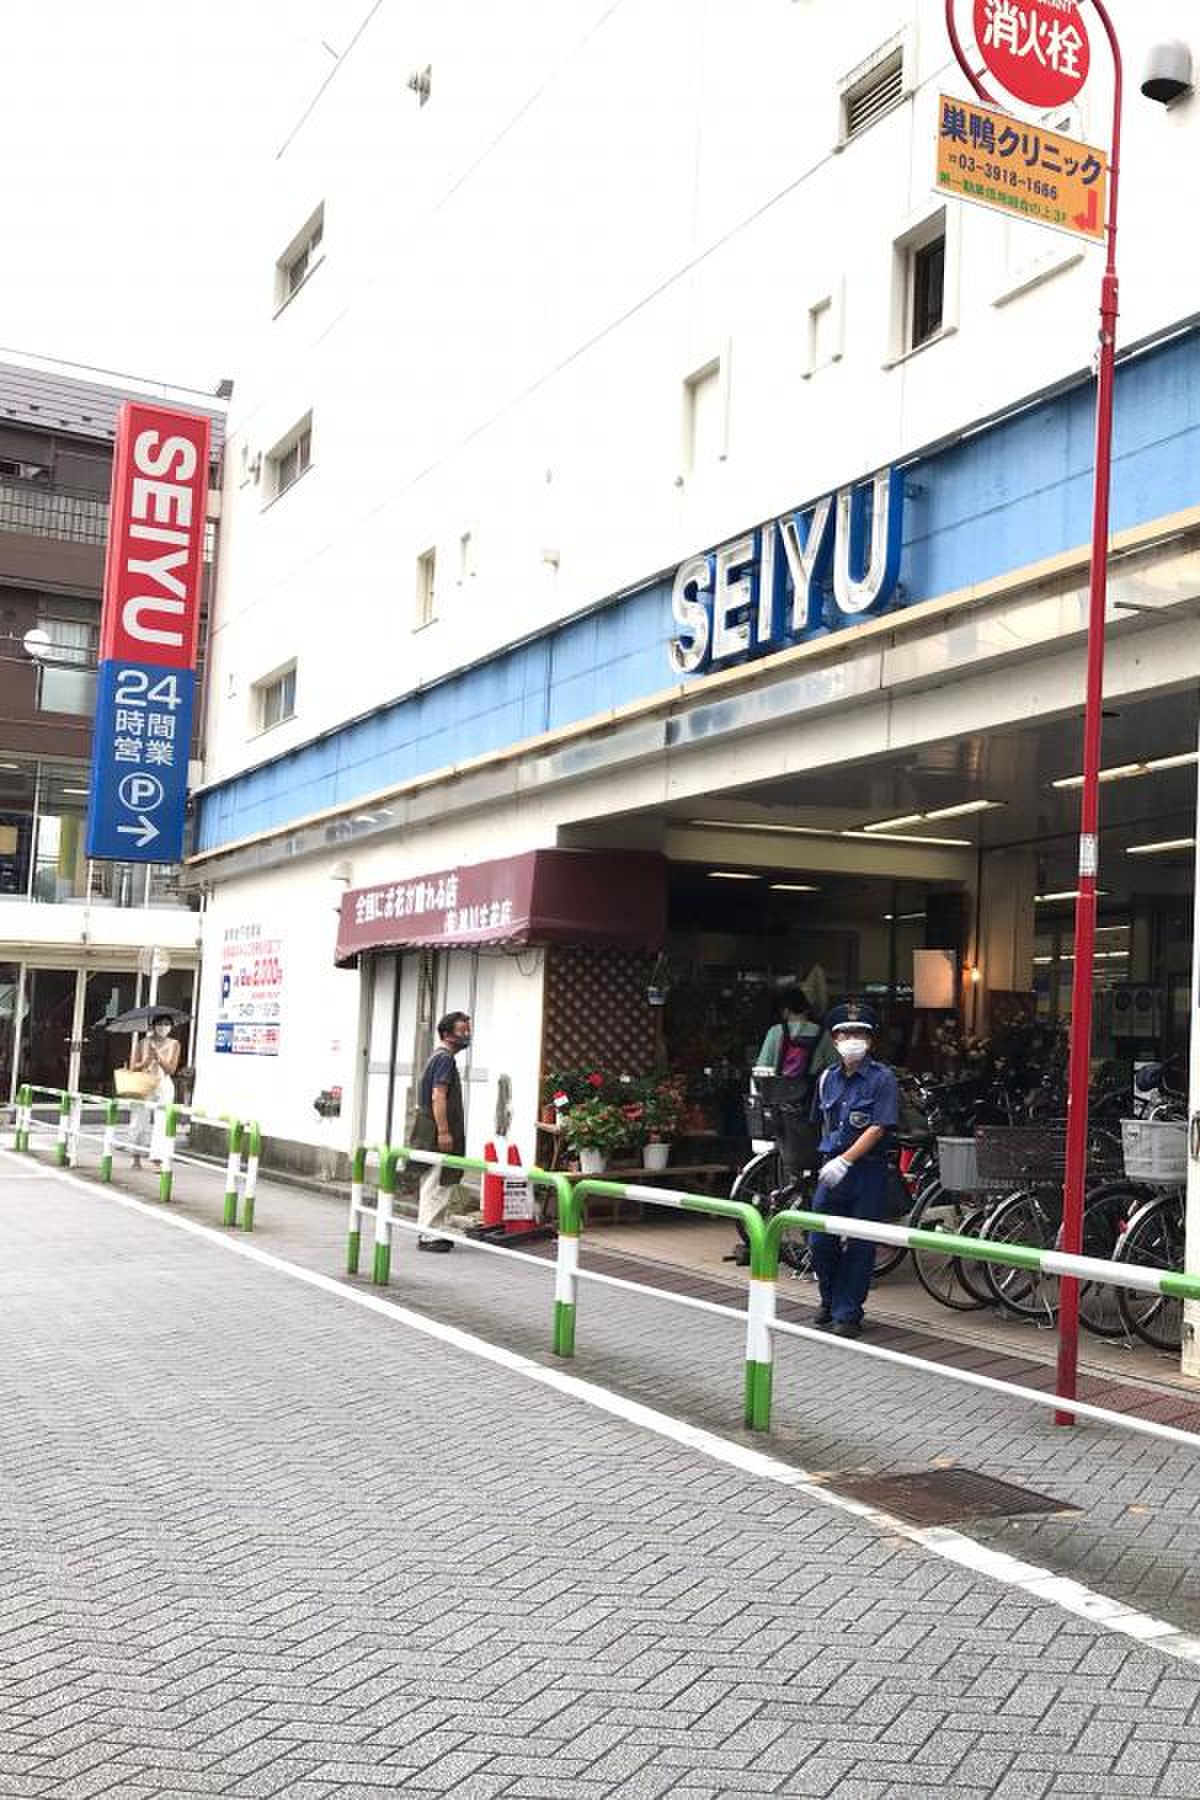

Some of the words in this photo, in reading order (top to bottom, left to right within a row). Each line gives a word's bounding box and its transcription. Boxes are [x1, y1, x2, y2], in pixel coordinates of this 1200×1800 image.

[983, 0, 1083, 79] 消火栓
[940, 102, 1102, 185] 巣鴨クリニック
[122, 429, 198, 647] SEIYU
[670, 466, 893, 674] SEIYU
[114, 670, 181, 711] 24
